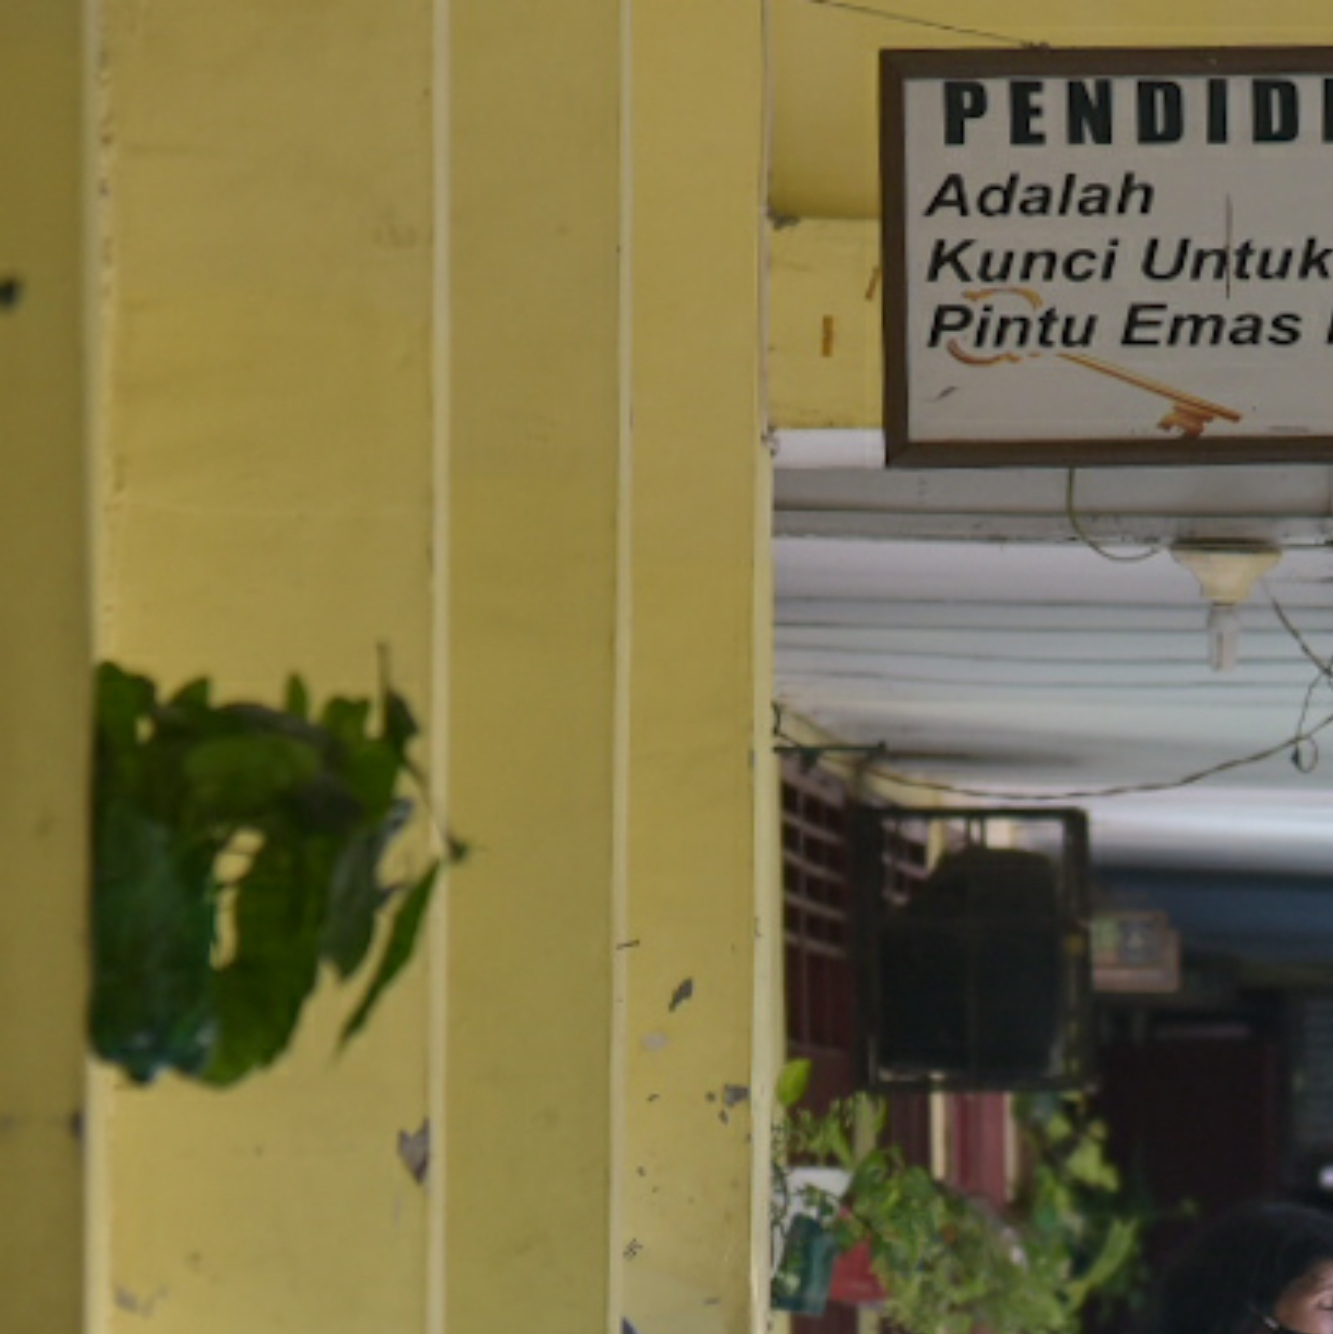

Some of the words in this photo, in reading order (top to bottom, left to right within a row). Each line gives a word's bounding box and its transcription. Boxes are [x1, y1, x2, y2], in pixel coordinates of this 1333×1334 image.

[923, 172, 1155, 218] Adalah
[925, 237, 1120, 282] Kunci
[928, 303, 1096, 349] Pintu
[1120, 304, 1302, 346] Emas
